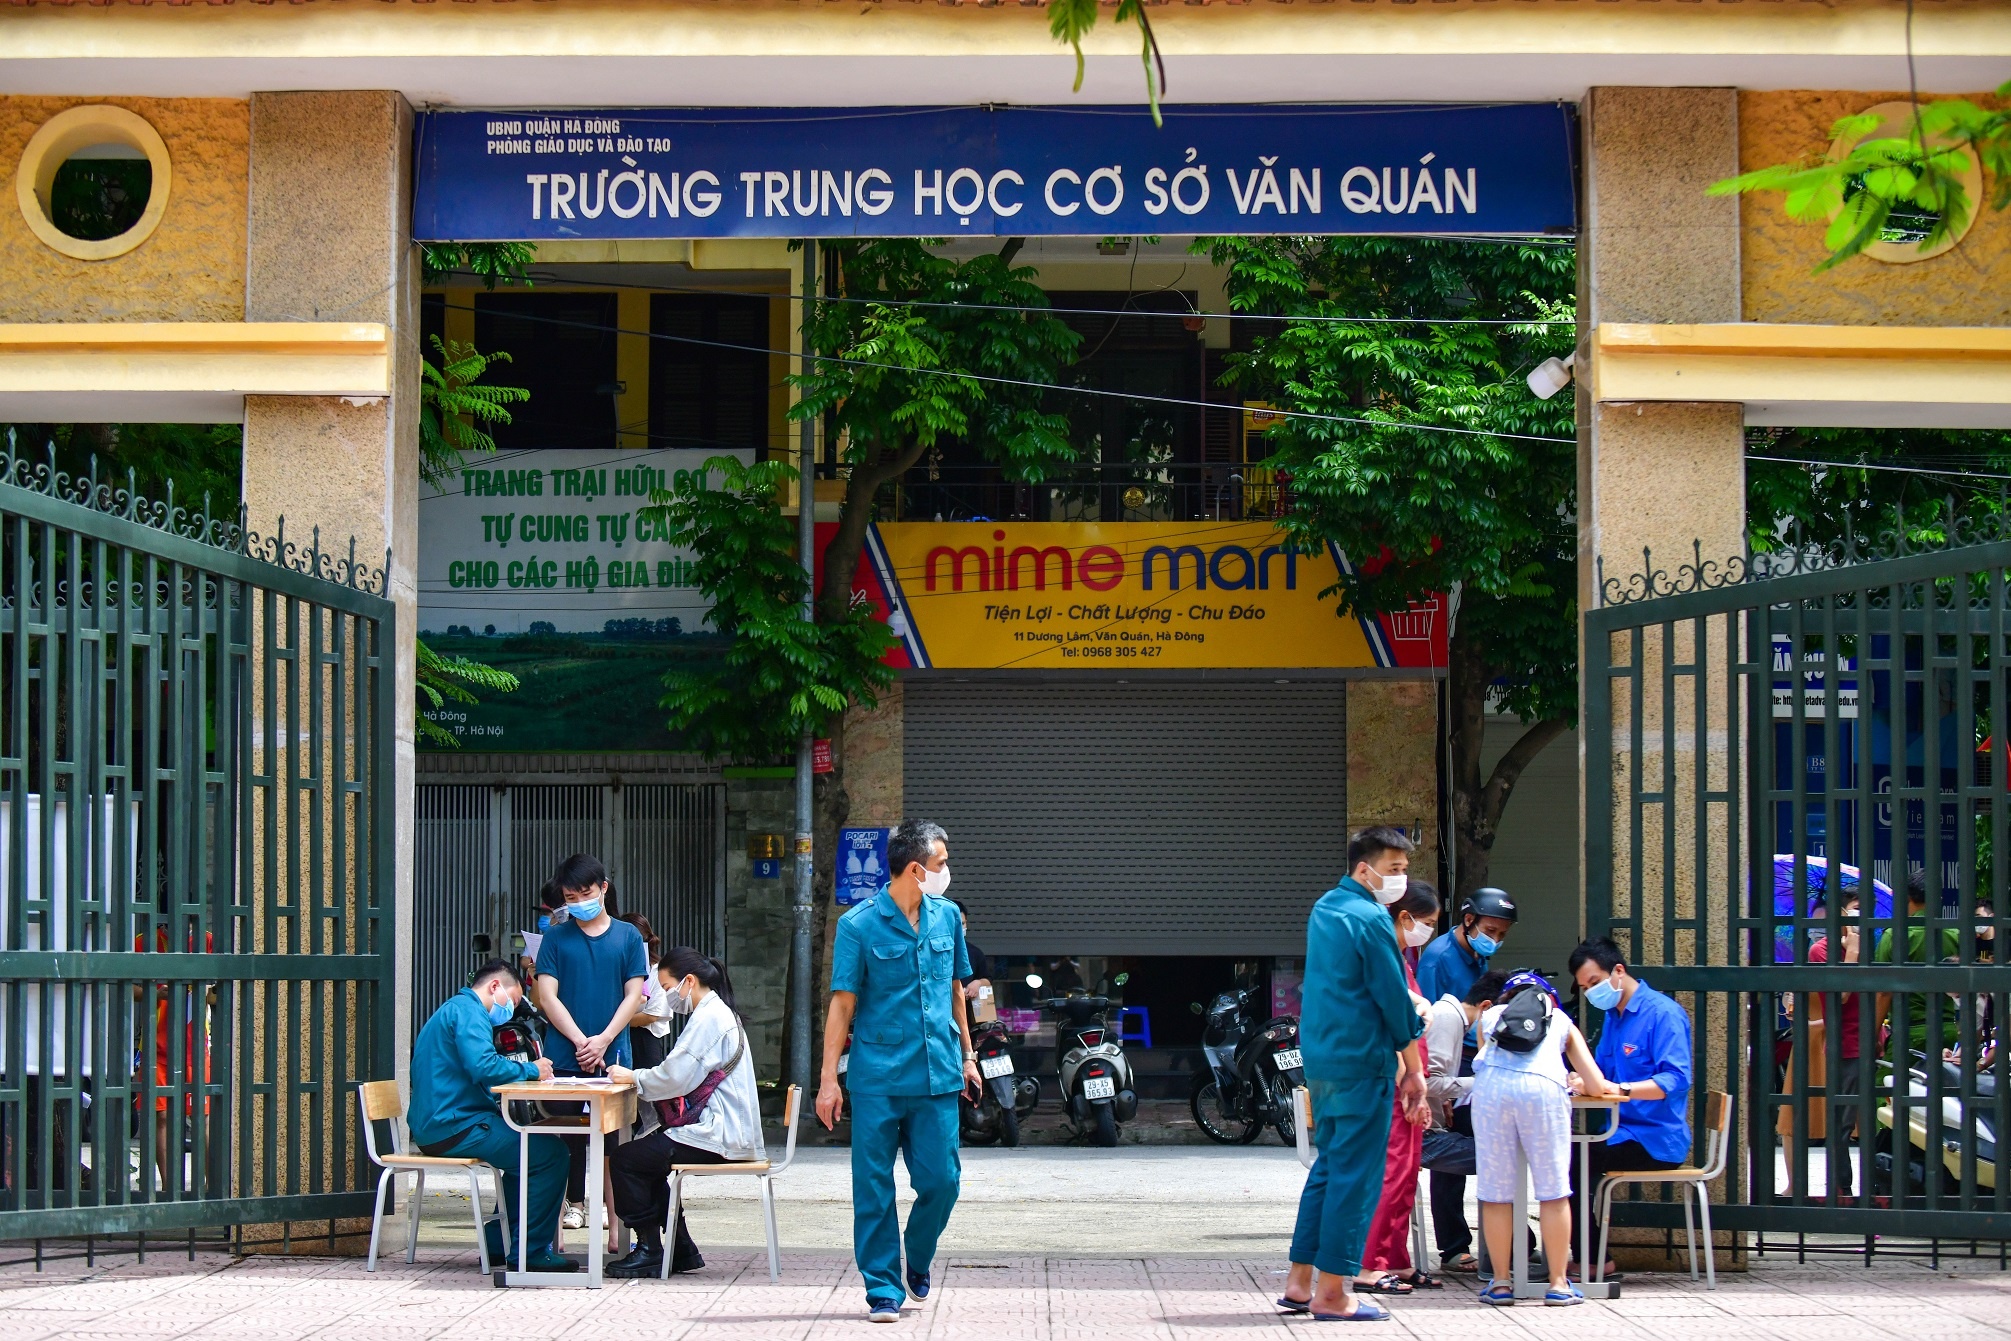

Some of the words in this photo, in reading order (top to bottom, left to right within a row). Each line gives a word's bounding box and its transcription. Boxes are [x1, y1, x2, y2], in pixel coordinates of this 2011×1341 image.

[487, 121, 522, 135] UBND
[525, 117, 561, 137] QUẬN
[584, 116, 620, 134] ĐÔNG
[487, 137, 531, 154] PHÒNG
[535, 136, 565, 153] GIÁO
[568, 139, 593, 155] DỤC
[597, 135, 614, 153] VÀ
[617, 134, 643, 153] ĐÀO
[647, 138, 671, 154] TẠO
[527, 156, 722, 219] TRƯỜNG
[740, 168, 894, 218] TRUNG
[914, 167, 1024, 225] HỌC
[1044, 165, 1124, 217] CƠ
[1144, 146, 1210, 215] SỞ
[1226, 155, 1322, 215] VĂN
[1340, 151, 1477, 214] QUÁN
[461, 469, 543, 496] TRANG
[551, 469, 607, 502] TRẠI
[481, 512, 515, 548] TỰ
[520, 515, 589, 542] CUNG
[596, 512, 630, 548] TỰ
[925, 529, 1125, 591] mime
[449, 560, 499, 588] CHO
[507, 555, 558, 588] CÁC
[566, 555, 599, 593] HỘ
[607, 560, 650, 588] GIA
[984, 605, 1020, 624] Tiện
[1026, 605, 1052, 624] Lợi
[1068, 603, 1110, 620] Chất
[1115, 605, 1172, 624] Lượng
[1188, 605, 1223, 620] Chu
[1229, 604, 1266, 620] Đáo
[1014, 632, 1025, 641] 11
[1027, 632, 1063, 644] Dương
[1066, 631, 1093, 643] Lâm,
[1095, 631, 1117, 641] Văn
[1120, 631, 1153, 643] Quán,
[1157, 631, 1172, 641] Hà
[1174, 631, 1205, 643] Đông
[1061, 647, 1079, 657] Tel:
[1082, 647, 1112, 657] 0968
[1115, 647, 1137, 657] 305
[1140, 647, 1162, 657] 427
[423, 711, 437, 720] Hà
[440, 710, 467, 722] Đông
[455, 725, 468, 735] TP.
[470, 725, 484, 735] Hà
[487, 725, 504, 738] Nội
[846, 832, 878, 840] POCARI
[762, 862, 770, 875] 9
[1086, 1087, 1113, 1097] 365.93
[1087, 1079, 1109, 1089] 29-X5
